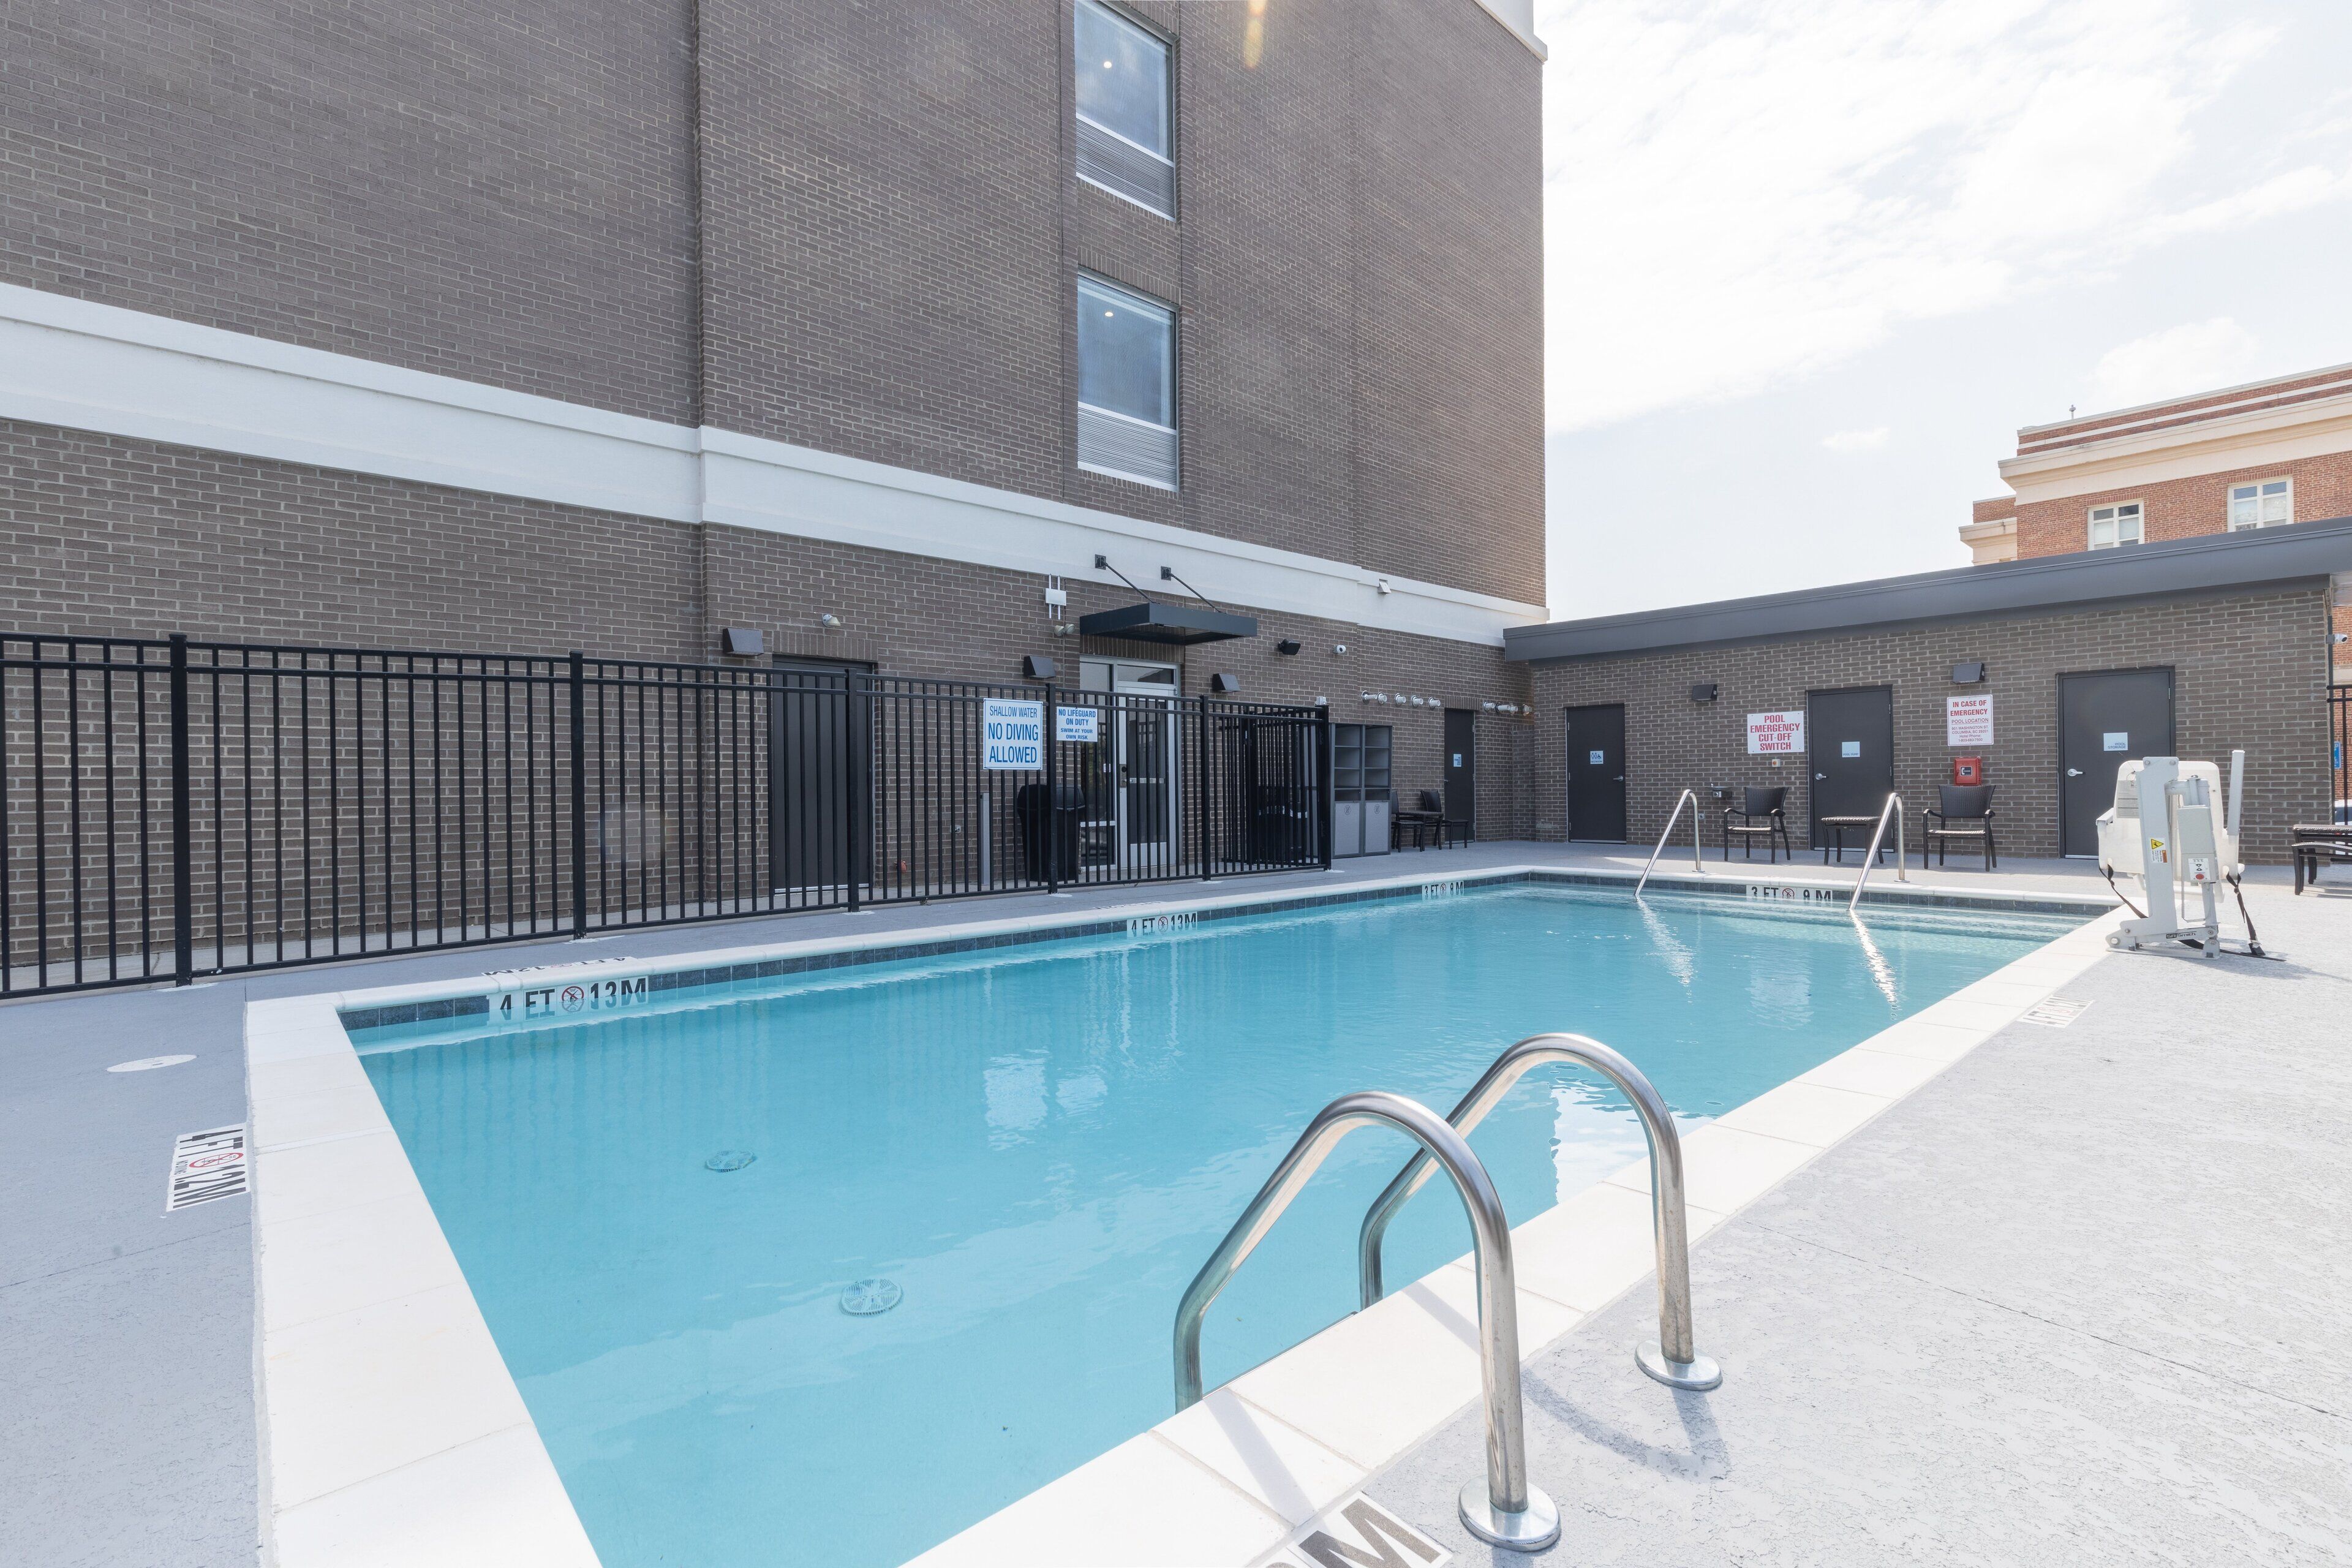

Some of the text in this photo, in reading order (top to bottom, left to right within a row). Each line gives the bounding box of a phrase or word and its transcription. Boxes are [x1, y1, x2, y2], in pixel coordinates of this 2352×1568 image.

[989, 705, 1037, 718] SHALLOW WATER
[1068, 709, 1096, 718] LIFEGUARD
[1764, 714, 1785, 723] POOL
[988, 723, 1038, 741] NO DIVING
[1750, 723, 1800, 733] EMERGENCY
[1758, 733, 1792, 742] CUT-OFF
[1760, 742, 1791, 751] SWITCH
[989, 745, 1037, 763] ALLOWED
[1142, 918, 1155, 929] FT
[500, 994, 511, 1010] 4
[526, 989, 556, 1008] FT
[179, 1129, 243, 1144] 4
[178, 1136, 243, 1158] FT
